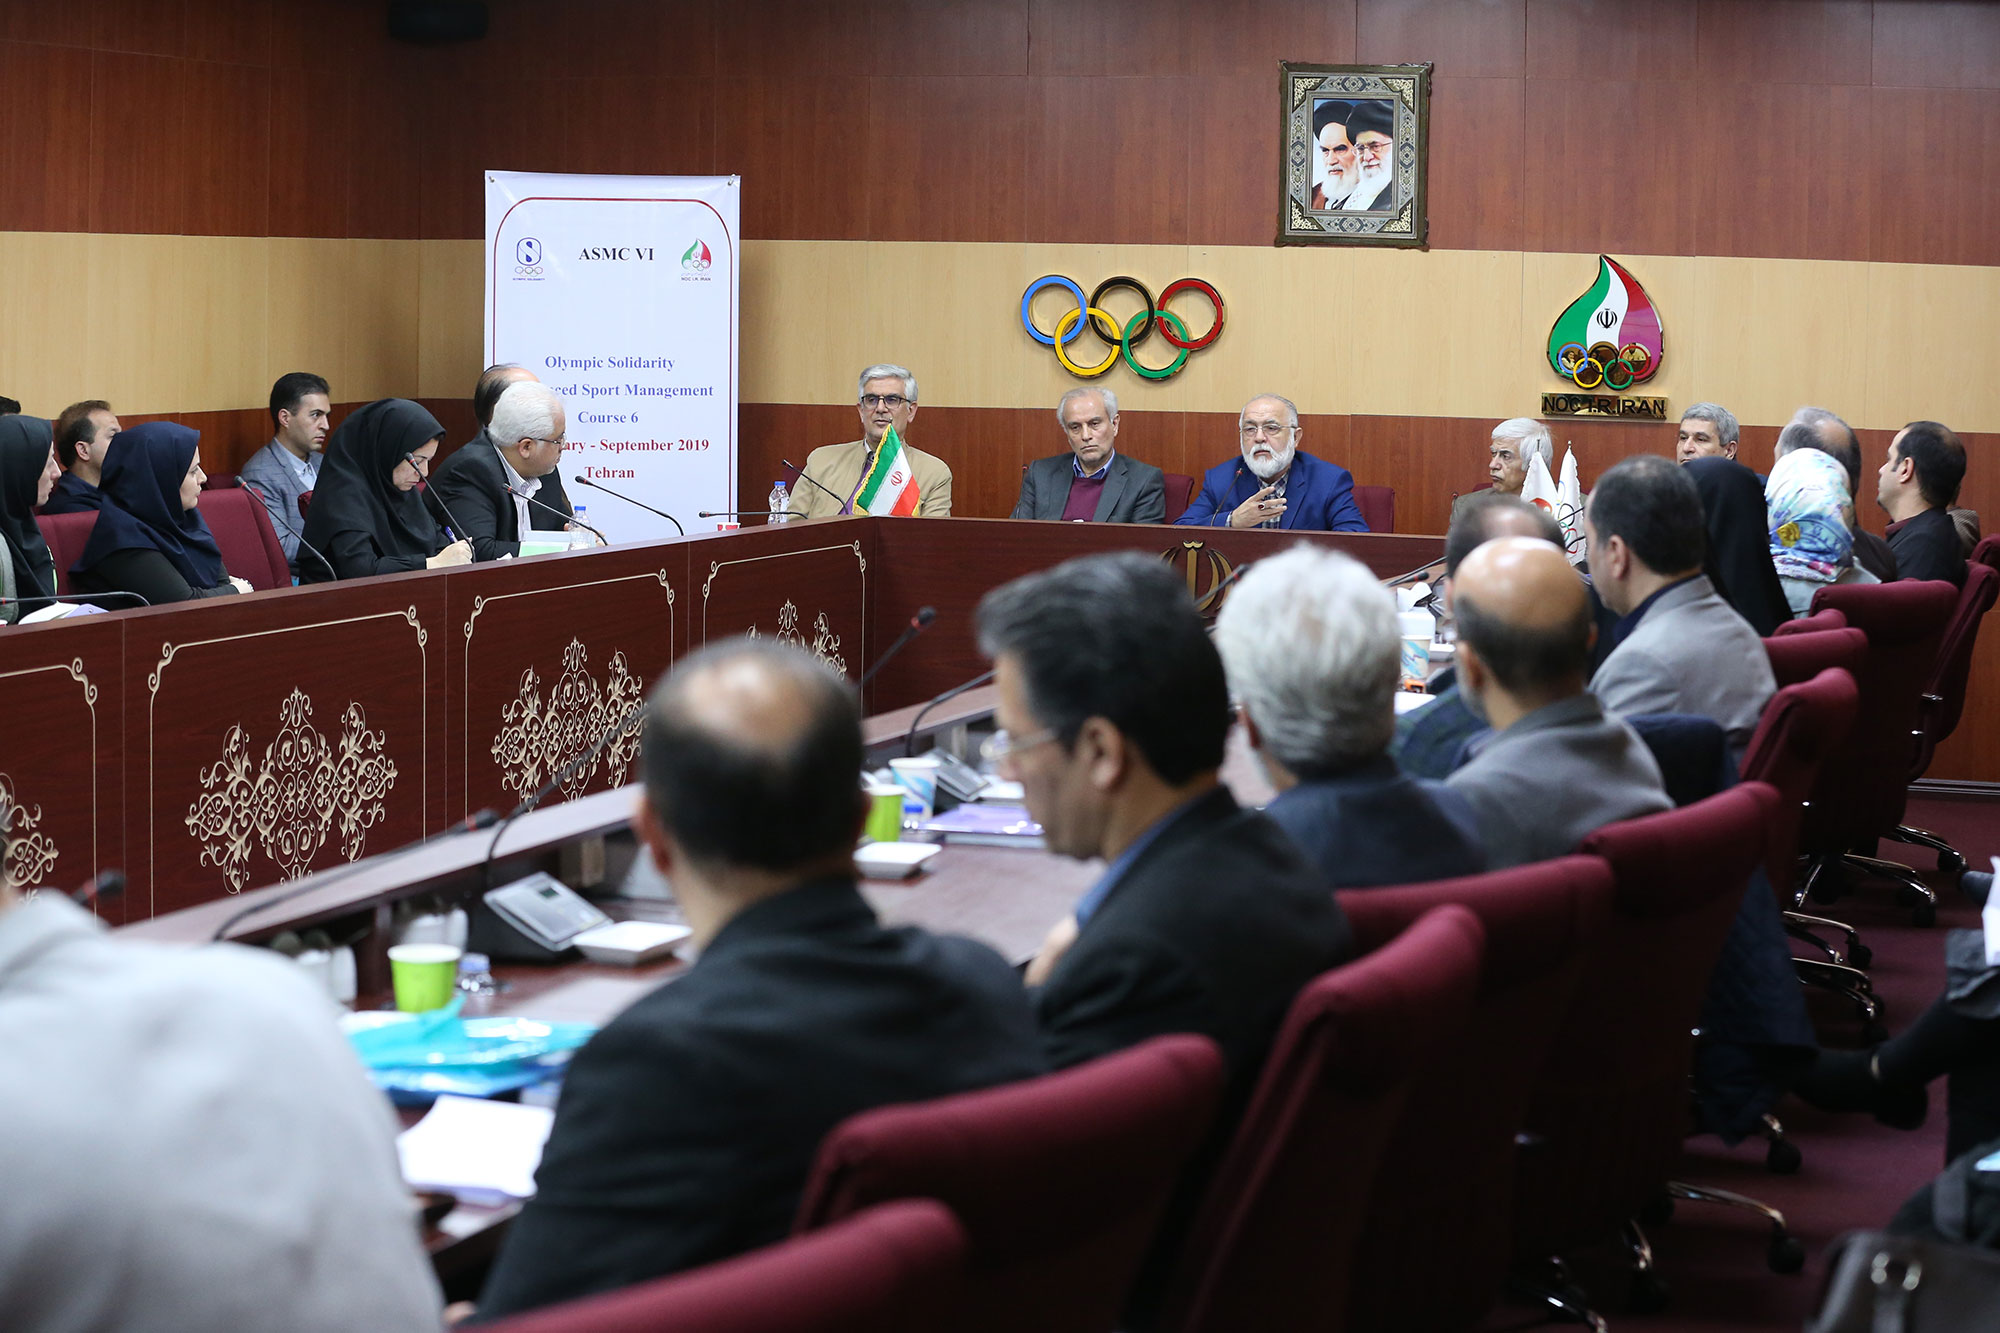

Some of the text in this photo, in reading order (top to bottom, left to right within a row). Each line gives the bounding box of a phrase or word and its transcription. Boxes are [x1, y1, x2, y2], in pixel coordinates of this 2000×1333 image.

[578, 247, 654, 261] ASMC VI
[544, 356, 676, 372] Olympic Solidarity
[581, 383, 620, 399] Sport
[624, 384, 714, 399] Management
[1543, 396, 1581, 413] NOC
[577, 410, 639, 424] Course 6
[599, 439, 674, 454] September
[677, 439, 710, 451] 2019
[584, 466, 635, 479] Tehran
